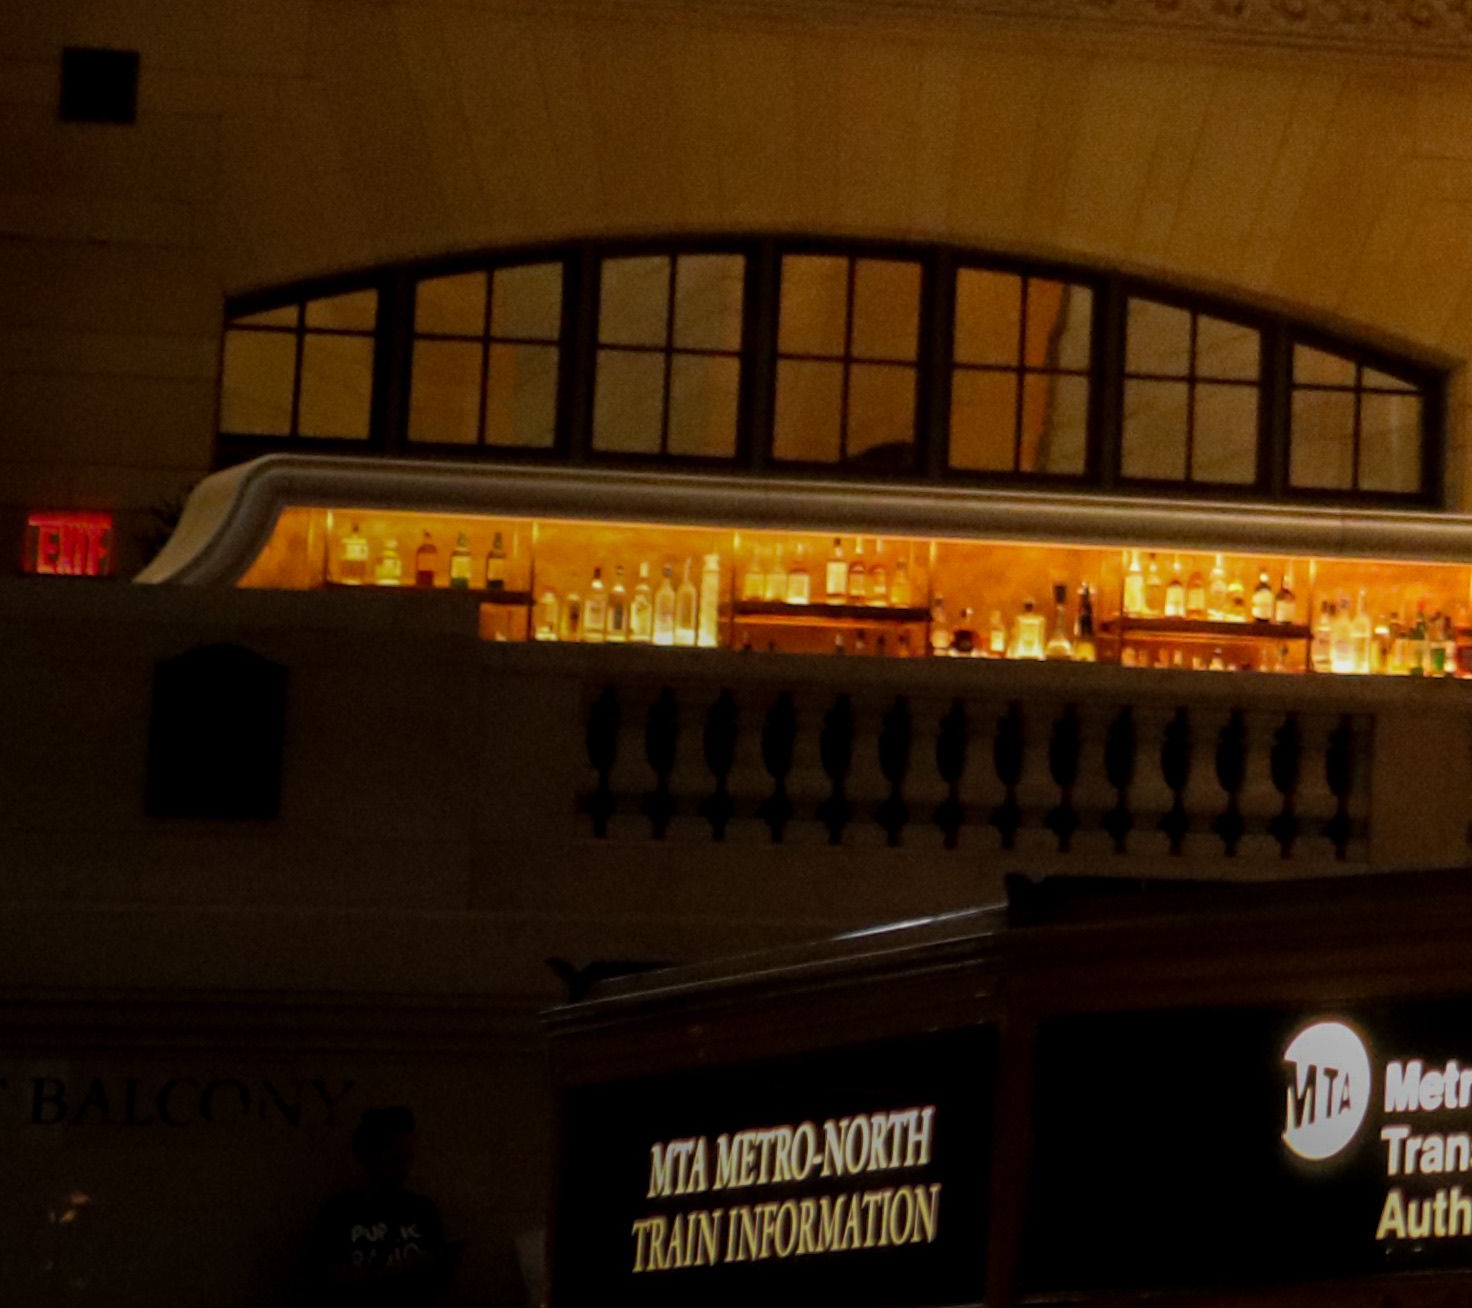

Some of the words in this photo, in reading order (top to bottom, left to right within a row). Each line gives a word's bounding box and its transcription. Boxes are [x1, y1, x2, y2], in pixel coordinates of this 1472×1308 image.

[31, 1077, 355, 1127] BALCONY
[1285, 1059, 1353, 1132] MTA
[646, 1136, 709, 1199] MTA
[712, 1104, 937, 1191] METRO-NORTH
[631, 1207, 723, 1274] TRAIN
[723, 1183, 942, 1263] INFORMATION
